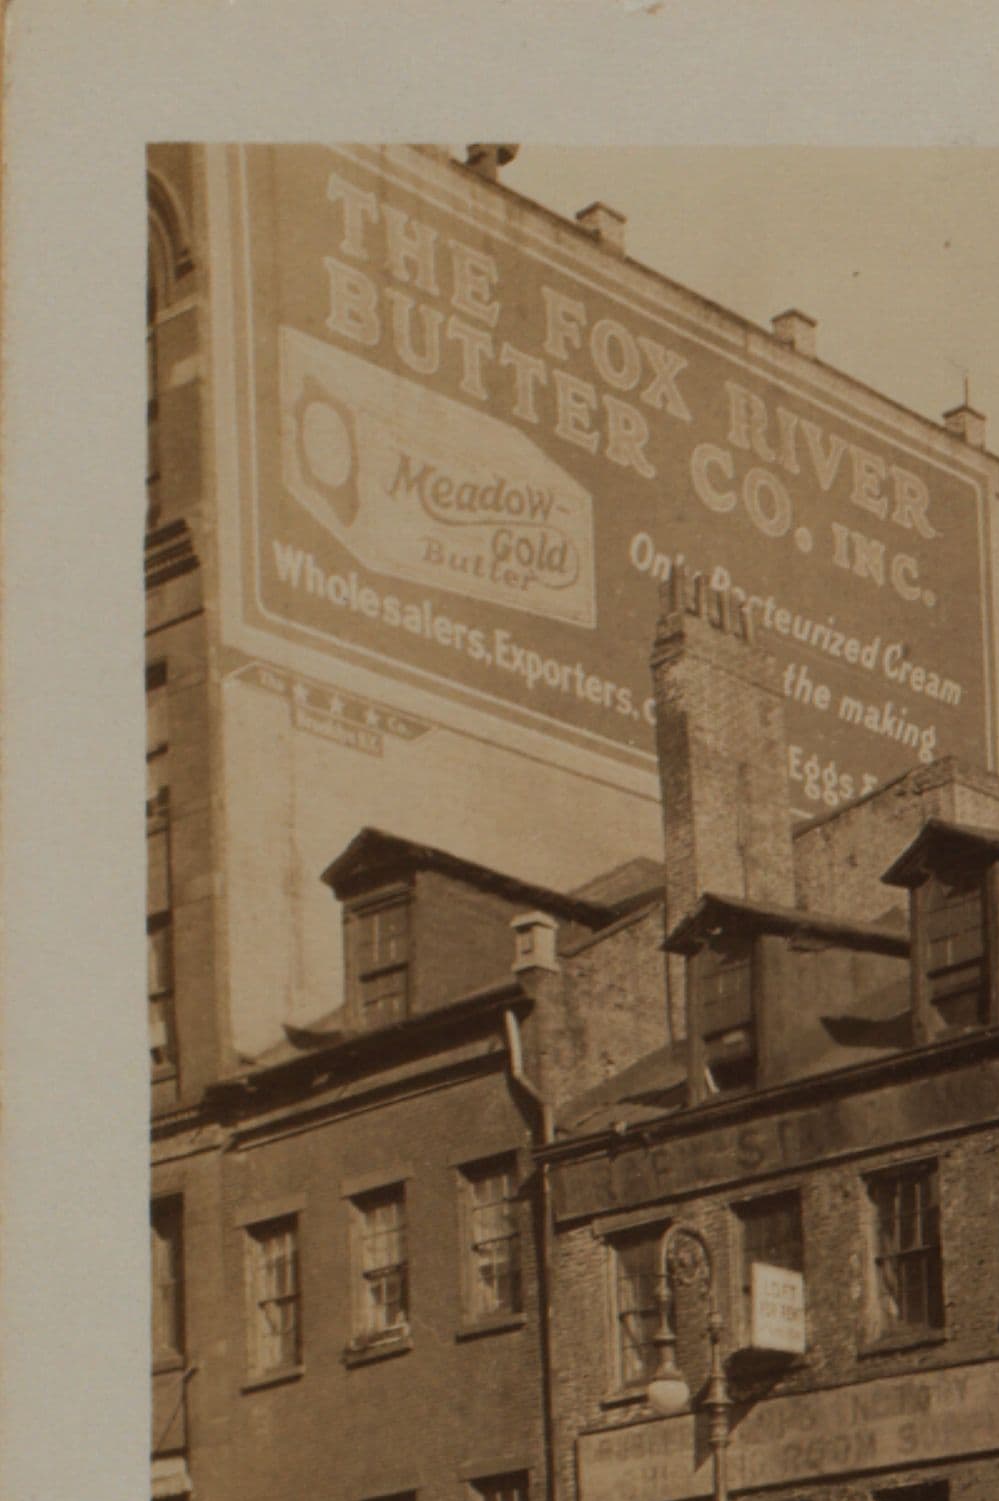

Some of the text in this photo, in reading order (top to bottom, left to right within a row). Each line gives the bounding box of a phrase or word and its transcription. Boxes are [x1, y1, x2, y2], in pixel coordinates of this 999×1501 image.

[326, 172, 942, 539] THE FOX RIVER
[323, 256, 937, 608] BUTTER CO. INC.
[420, 536, 537, 591] Butter
[491, 527, 568, 574] Gold
[883, 642, 963, 705] Cream
[783, 663, 937, 764] the making
[788, 745, 854, 806] Eggs
